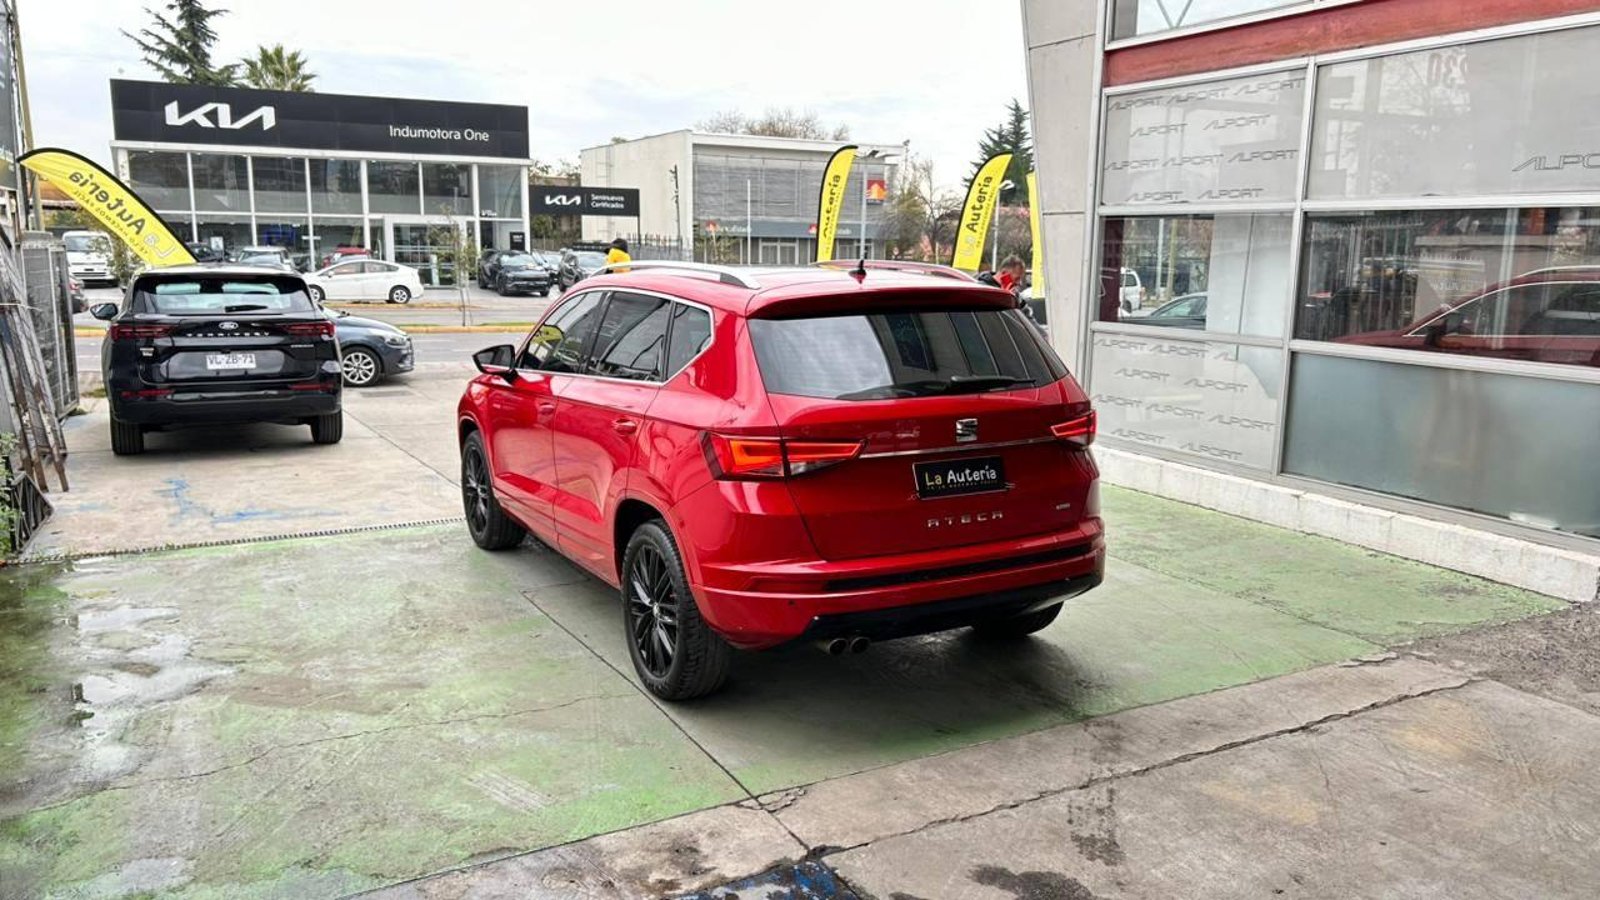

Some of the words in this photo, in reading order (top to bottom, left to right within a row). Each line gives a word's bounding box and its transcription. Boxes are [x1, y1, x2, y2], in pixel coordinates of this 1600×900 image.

[164, 100, 276, 131] KIA
[389, 125, 462, 140] Indumotora
[464, 128, 490, 142] One
[544, 194, 581, 206] KIA
[925, 471, 943, 486] La
[946, 464, 998, 484] Autería
[927, 510, 1003, 528] ATECA
